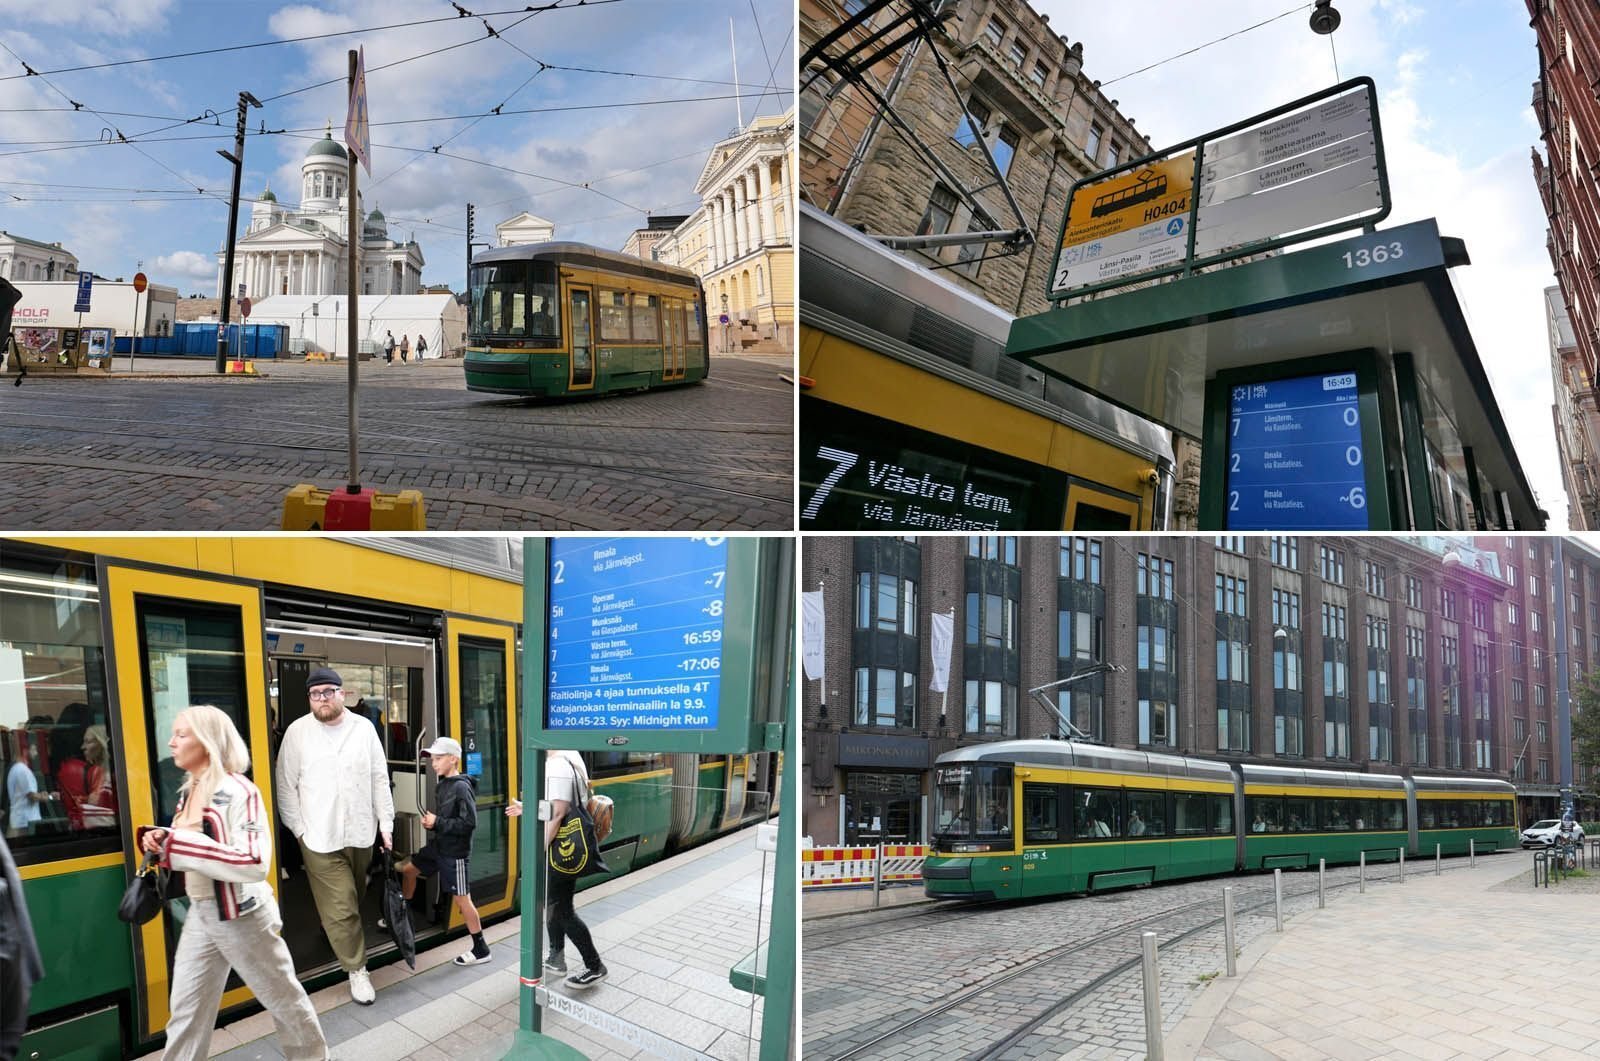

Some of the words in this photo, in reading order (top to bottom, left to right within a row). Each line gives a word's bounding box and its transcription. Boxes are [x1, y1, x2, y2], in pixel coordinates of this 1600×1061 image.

[1207, 167, 1217, 180] 5
[1143, 198, 1185, 222] H0404
[1087, 242, 1103, 251] HSL
[1099, 254, 1141, 270] Länsi-Pasila
[1342, 241, 1404, 269] 1363
[82, 273, 91, 288] P
[490, 267, 498, 282] 7
[1058, 270, 1068, 287] 2
[12, 308, 49, 317] HOLA
[1327, 376, 1352, 387] 16:49
[1343, 407, 1359, 426] 0
[1232, 418, 1241, 437] 7
[1231, 453, 1241, 472] 2
[1345, 445, 1361, 466] 0
[801, 446, 859, 520] 7
[868, 460, 955, 502] Västra
[963, 482, 1013, 514] term.
[1230, 490, 1240, 511] 2
[1339, 487, 1366, 509] ~6
[864, 500, 893, 522] via
[553, 560, 565, 584] 2
[592, 563, 604, 573] via
[592, 605, 601, 613] via
[551, 627, 558, 640] 4
[592, 628, 600, 637] via
[683, 629, 722, 645] 16:59
[551, 650, 557, 662] 7
[591, 652, 600, 660] via
[551, 671, 557, 683] 2
[590, 675, 599, 683] via
[551, 688, 592, 701] Raitiolinja
[594, 689, 601, 698] 4
[604, 689, 624, 699] ajaa
[627, 682, 690, 697] tunnuksella
[692, 681, 710, 693] 4T
[550, 703, 603, 714] Katajanokan
[607, 700, 667, 712] terminaaliin
[670, 699, 680, 710] la
[684, 698, 706, 709] 9.9.
[550, 717, 563, 727] klo
[565, 716, 608, 726] 20.45-23.
[610, 715, 631, 727] Syy:
[633, 714, 681, 727] Midnight
[684, 714, 708, 725] Run
[1084, 792, 1092, 806] 7
